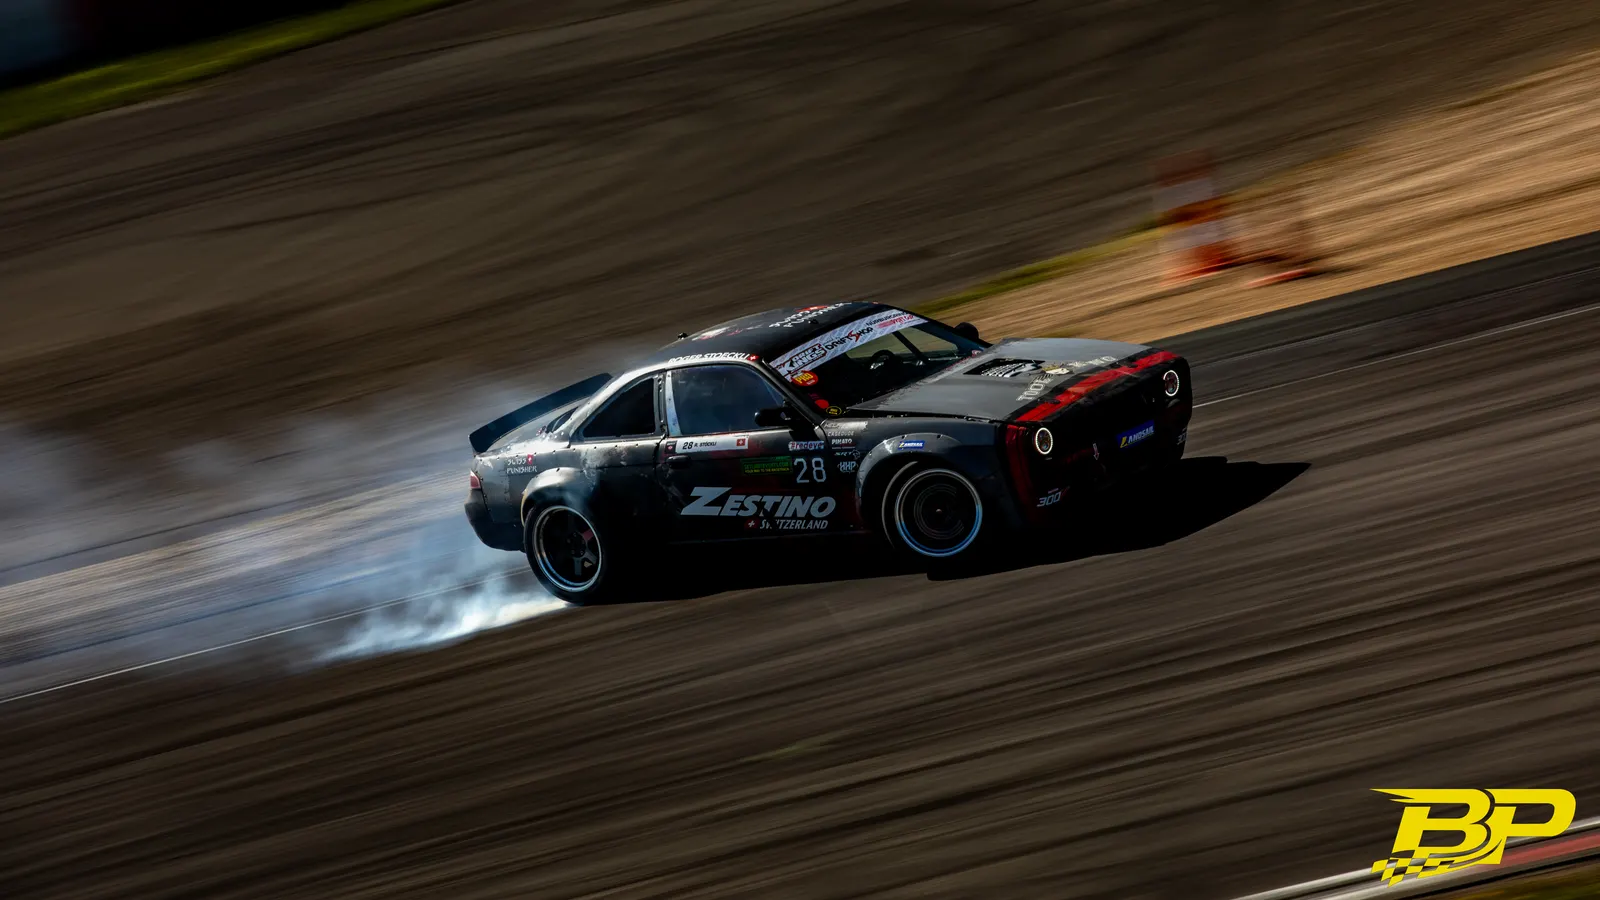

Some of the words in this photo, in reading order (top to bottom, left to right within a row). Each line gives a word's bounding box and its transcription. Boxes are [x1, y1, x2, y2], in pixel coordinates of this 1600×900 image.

[667, 354, 702, 364] ROGER
[703, 351, 750, 361] STOECKLI
[777, 350, 826, 376] KINGS
[682, 441, 693, 450] 28
[506, 466, 537, 474] PUNISHER
[793, 457, 826, 483] 28
[680, 486, 836, 518] ZESTINO
[1036, 491, 1062, 508] 300
